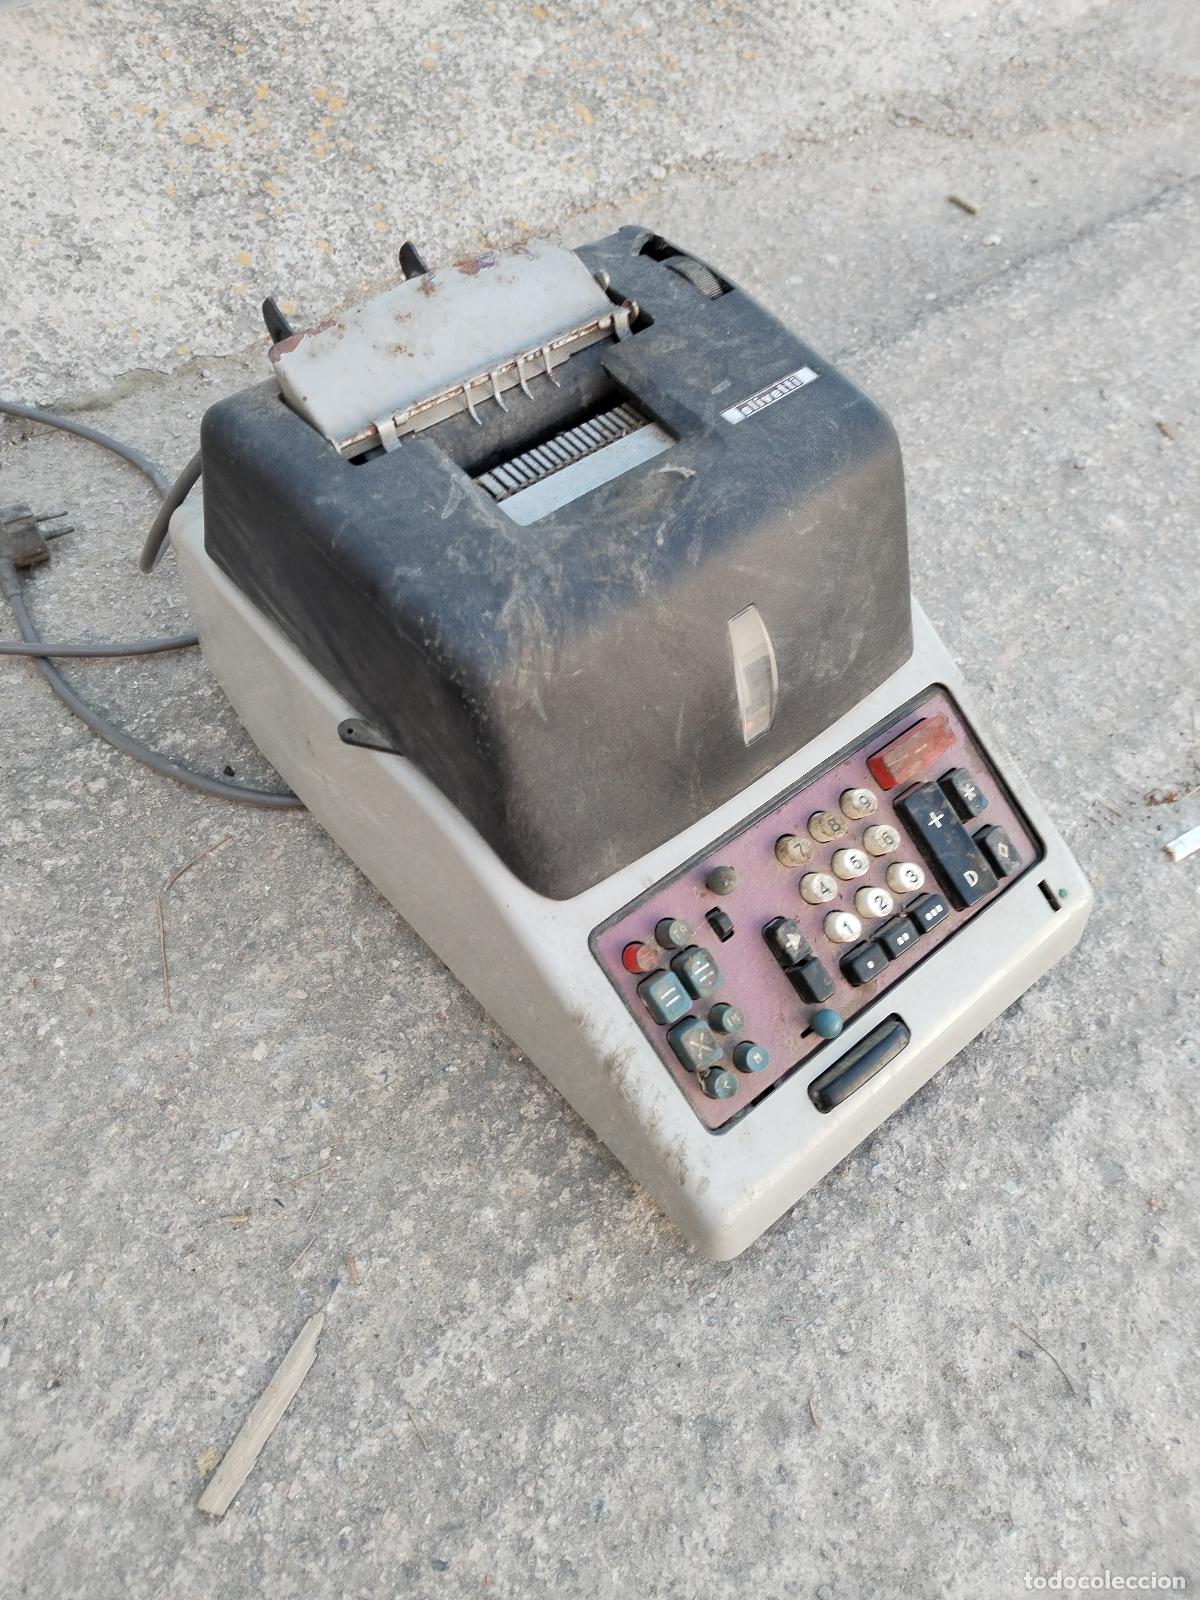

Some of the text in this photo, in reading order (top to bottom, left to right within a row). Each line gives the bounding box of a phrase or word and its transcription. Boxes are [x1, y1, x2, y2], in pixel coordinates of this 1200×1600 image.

[859, 795, 872, 809] 9
[828, 818, 841, 832] 8
[882, 831, 894, 845] 6
[793, 842, 806, 857] 7
[850, 855, 863, 870] 5
[905, 870, 918, 883] 3
[820, 881, 830, 894] 4
[874, 895, 888, 910] 2
[843, 923, 854, 934] 1
